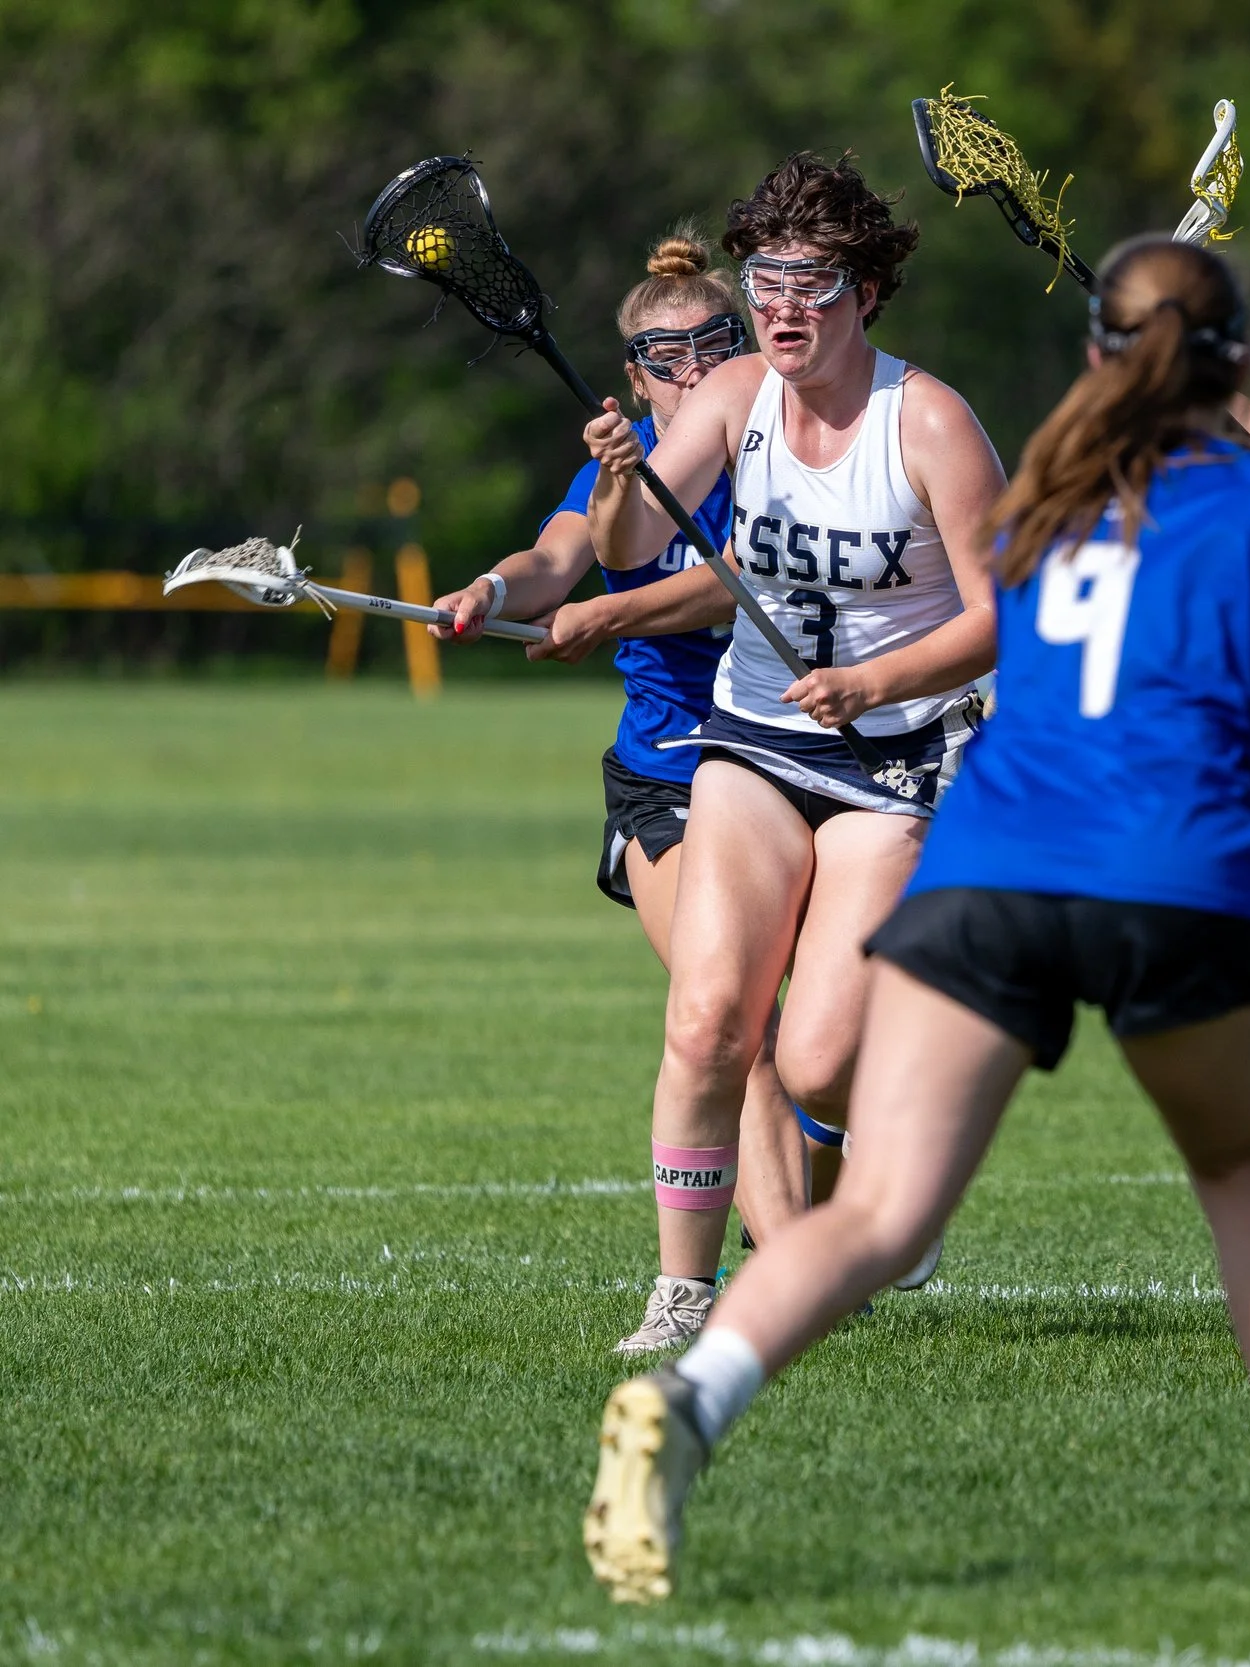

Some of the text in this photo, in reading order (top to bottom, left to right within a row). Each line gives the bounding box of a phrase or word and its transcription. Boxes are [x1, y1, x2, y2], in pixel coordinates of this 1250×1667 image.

[784, 586, 839, 669] 3
[1036, 539, 1142, 719] 9
[655, 1164, 723, 1187] CAPTAIN
